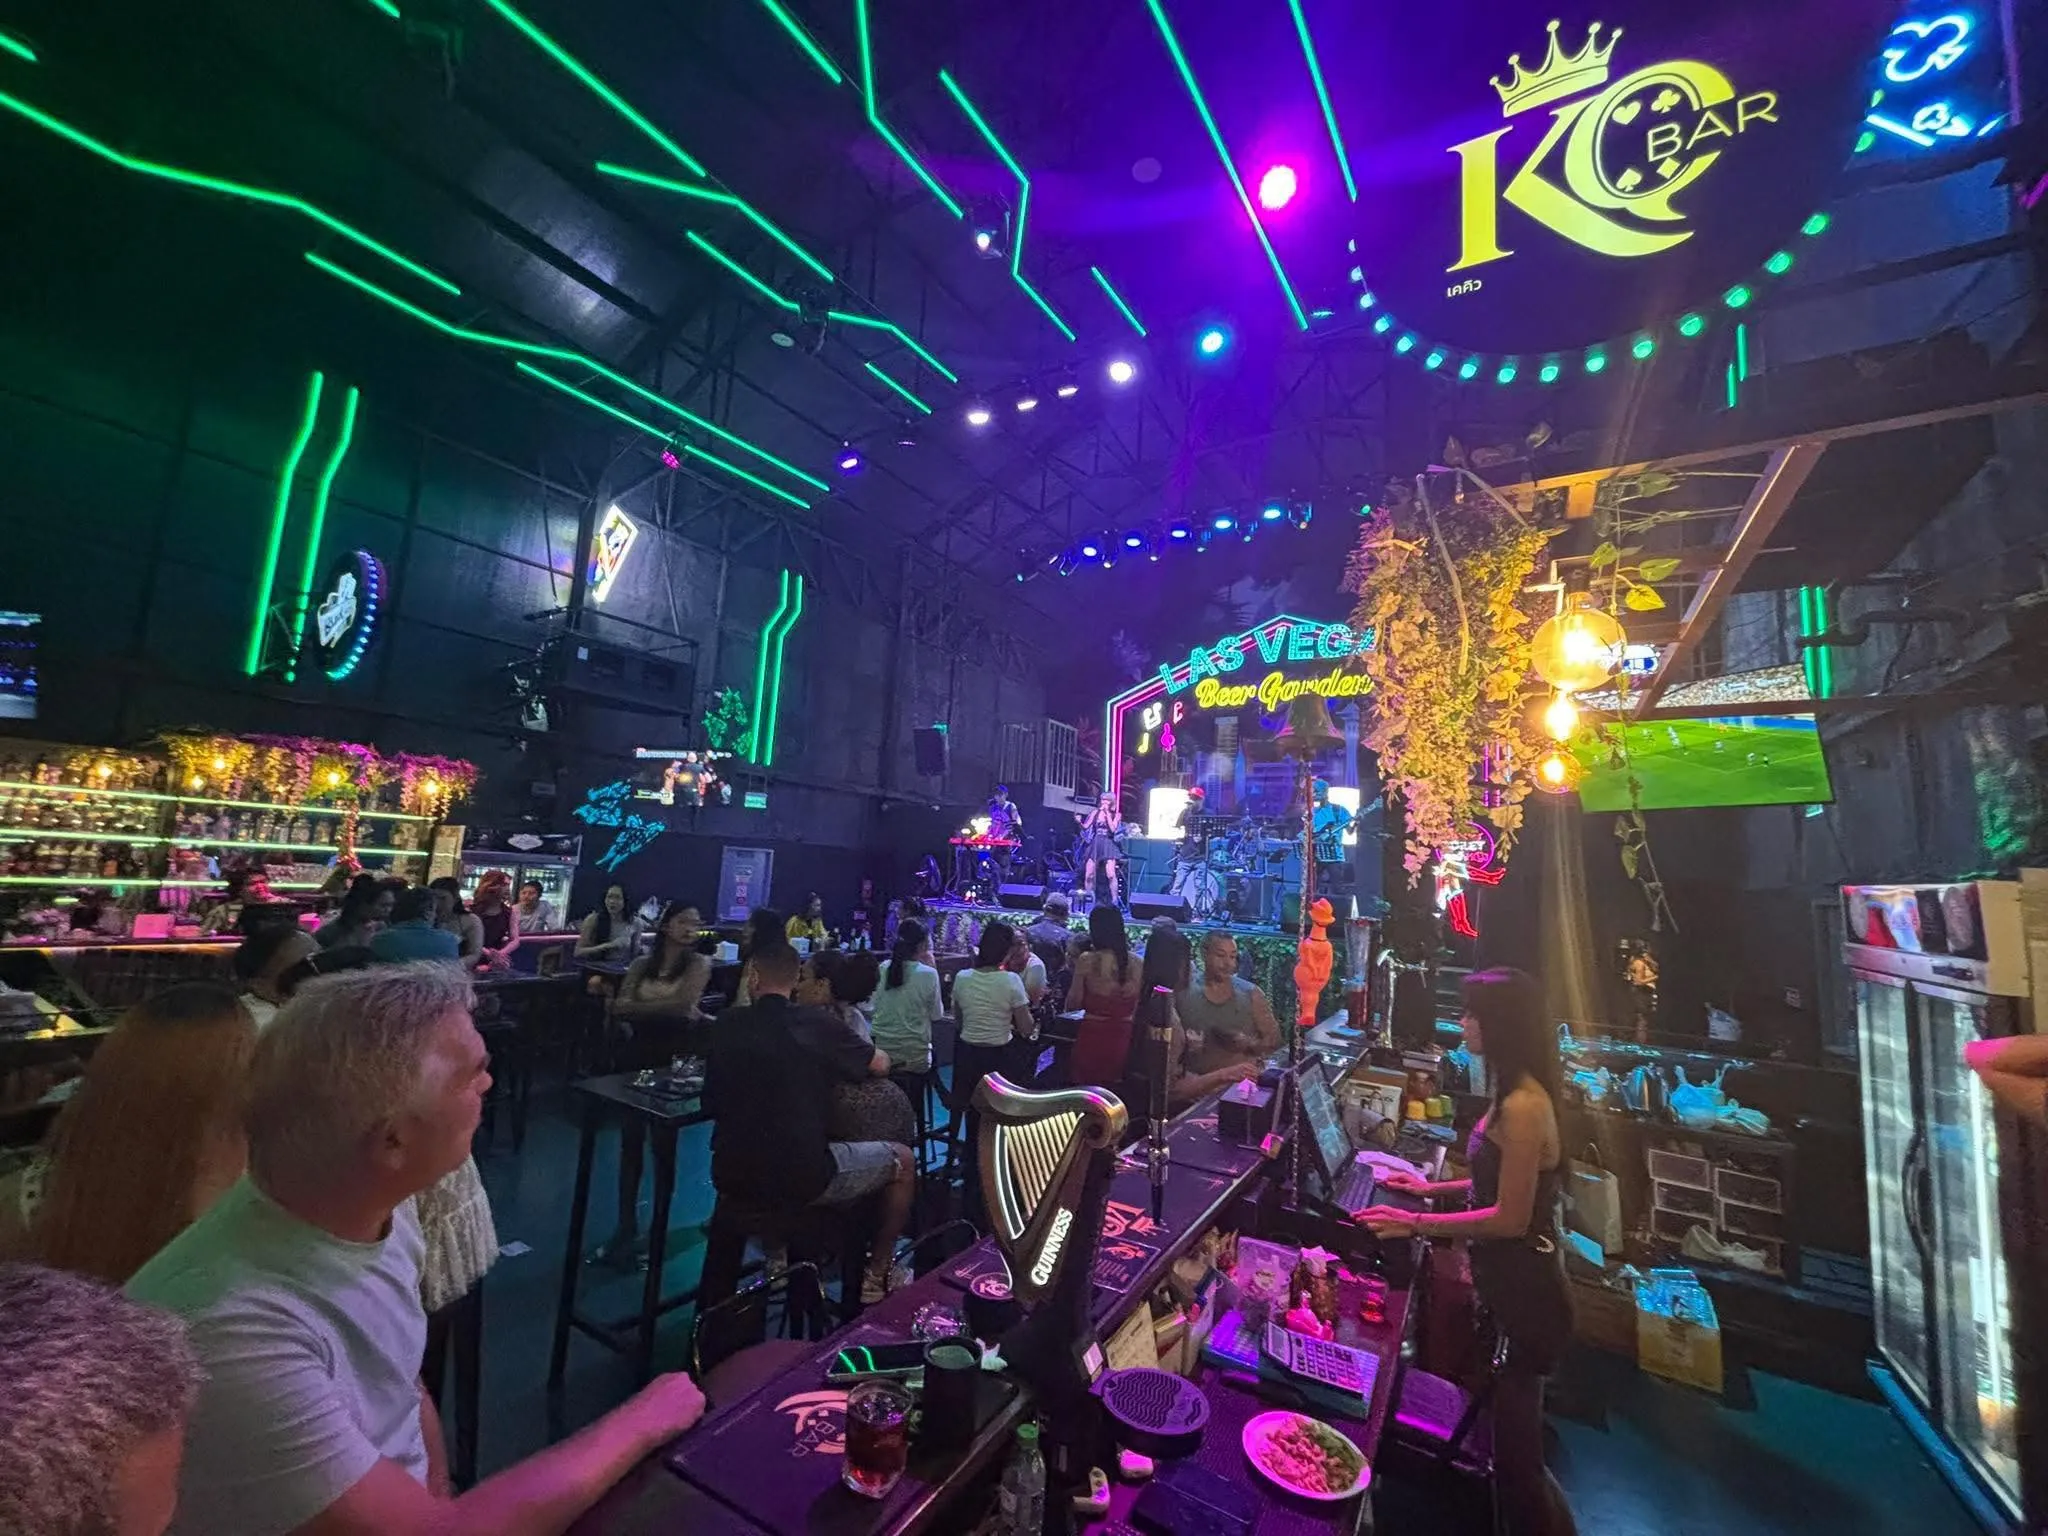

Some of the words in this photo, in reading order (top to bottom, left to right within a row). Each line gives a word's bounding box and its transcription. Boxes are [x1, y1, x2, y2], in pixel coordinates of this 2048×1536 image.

[1647, 91, 1778, 162] BAR
[1159, 636, 1245, 695] LAS
[1195, 678, 1257, 709] Beer
[1030, 1206, 1074, 1287] GUINNESS
